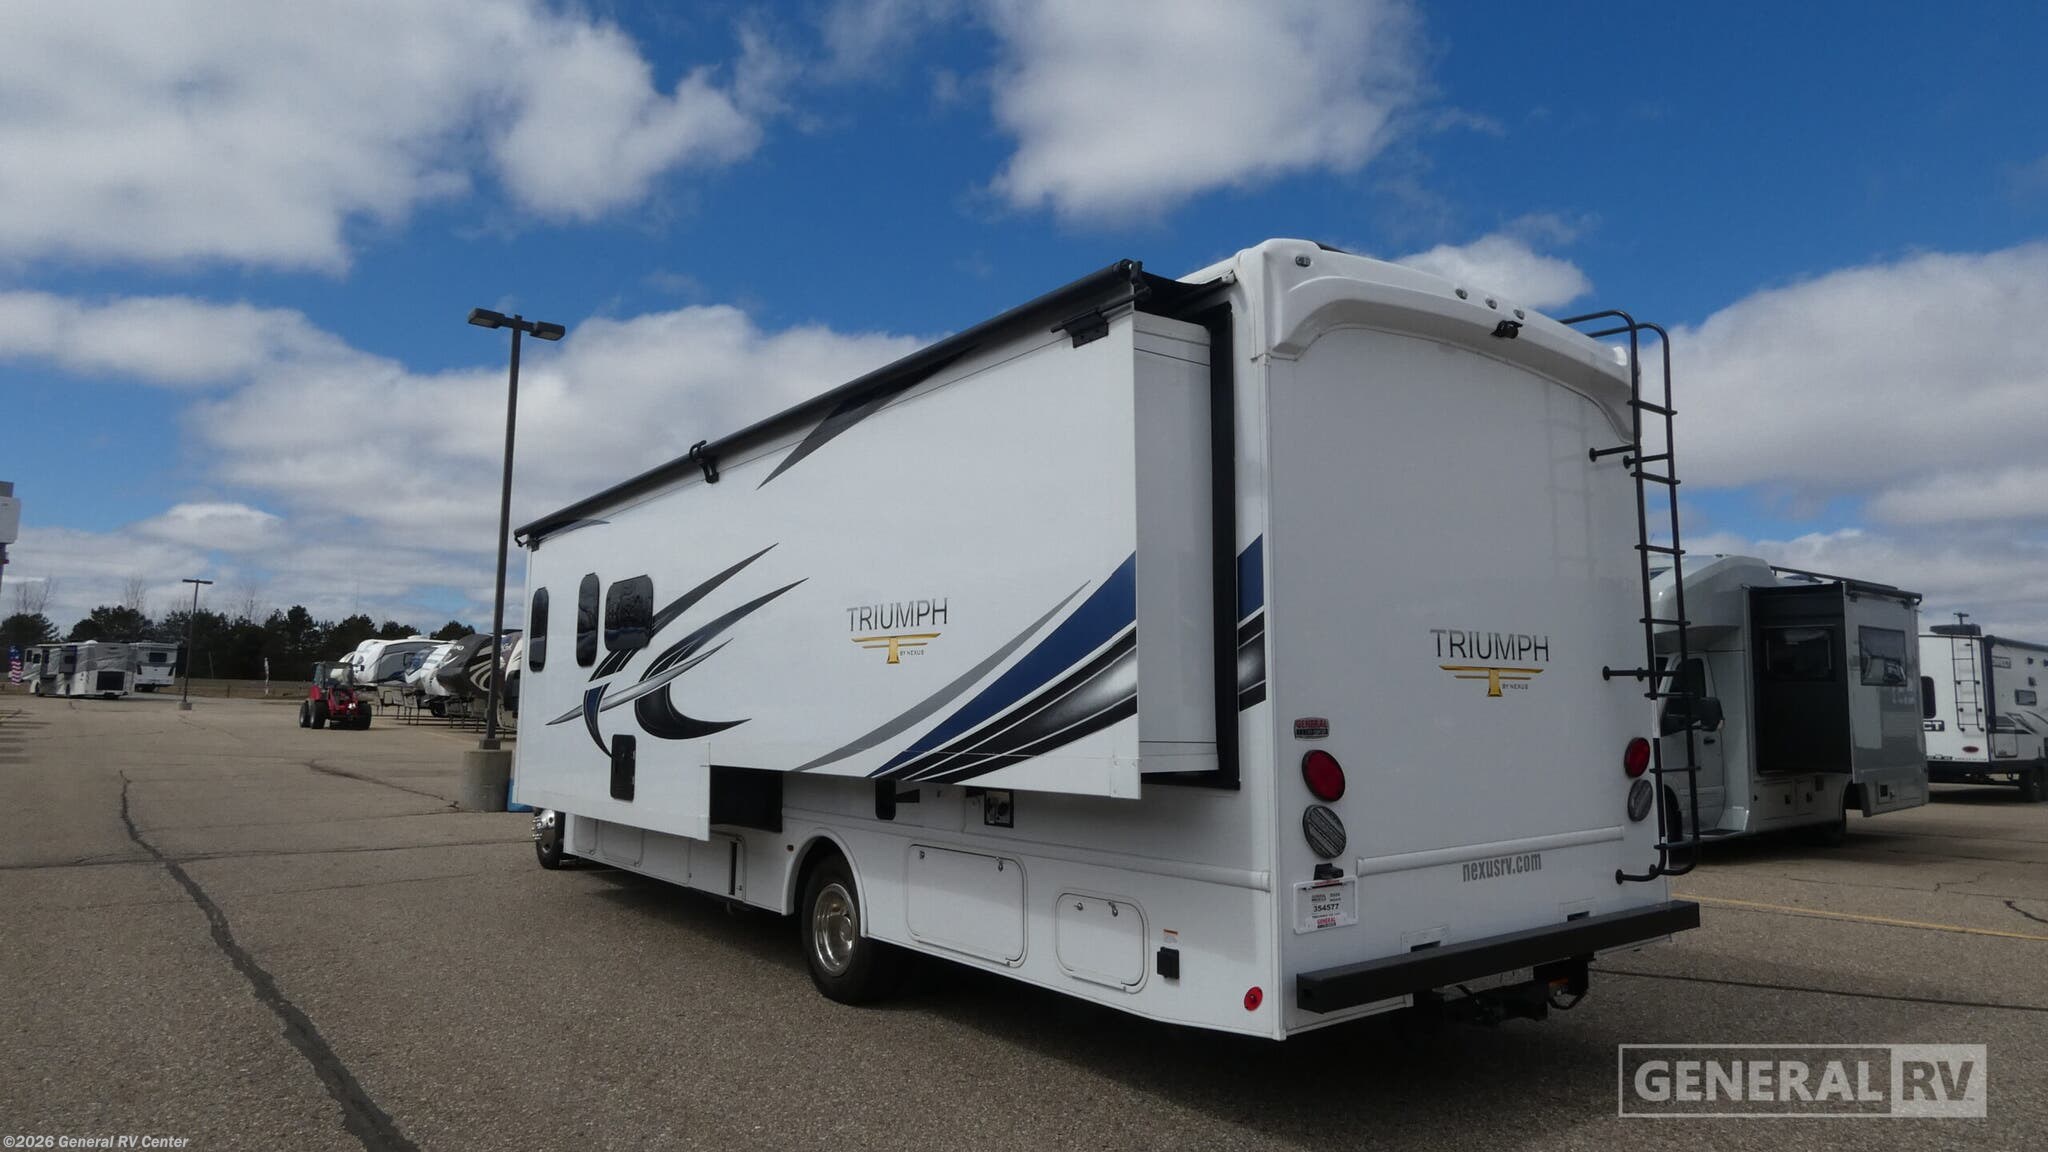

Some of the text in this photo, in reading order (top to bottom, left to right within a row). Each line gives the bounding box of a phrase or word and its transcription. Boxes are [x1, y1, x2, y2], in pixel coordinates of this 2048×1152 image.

[846, 597, 948, 632] TRIUMPH
[1430, 629, 1549, 662] TRIUMPH
[1462, 853, 1542, 883] nexusrv.com
[1313, 903, 1339, 913] 354577
